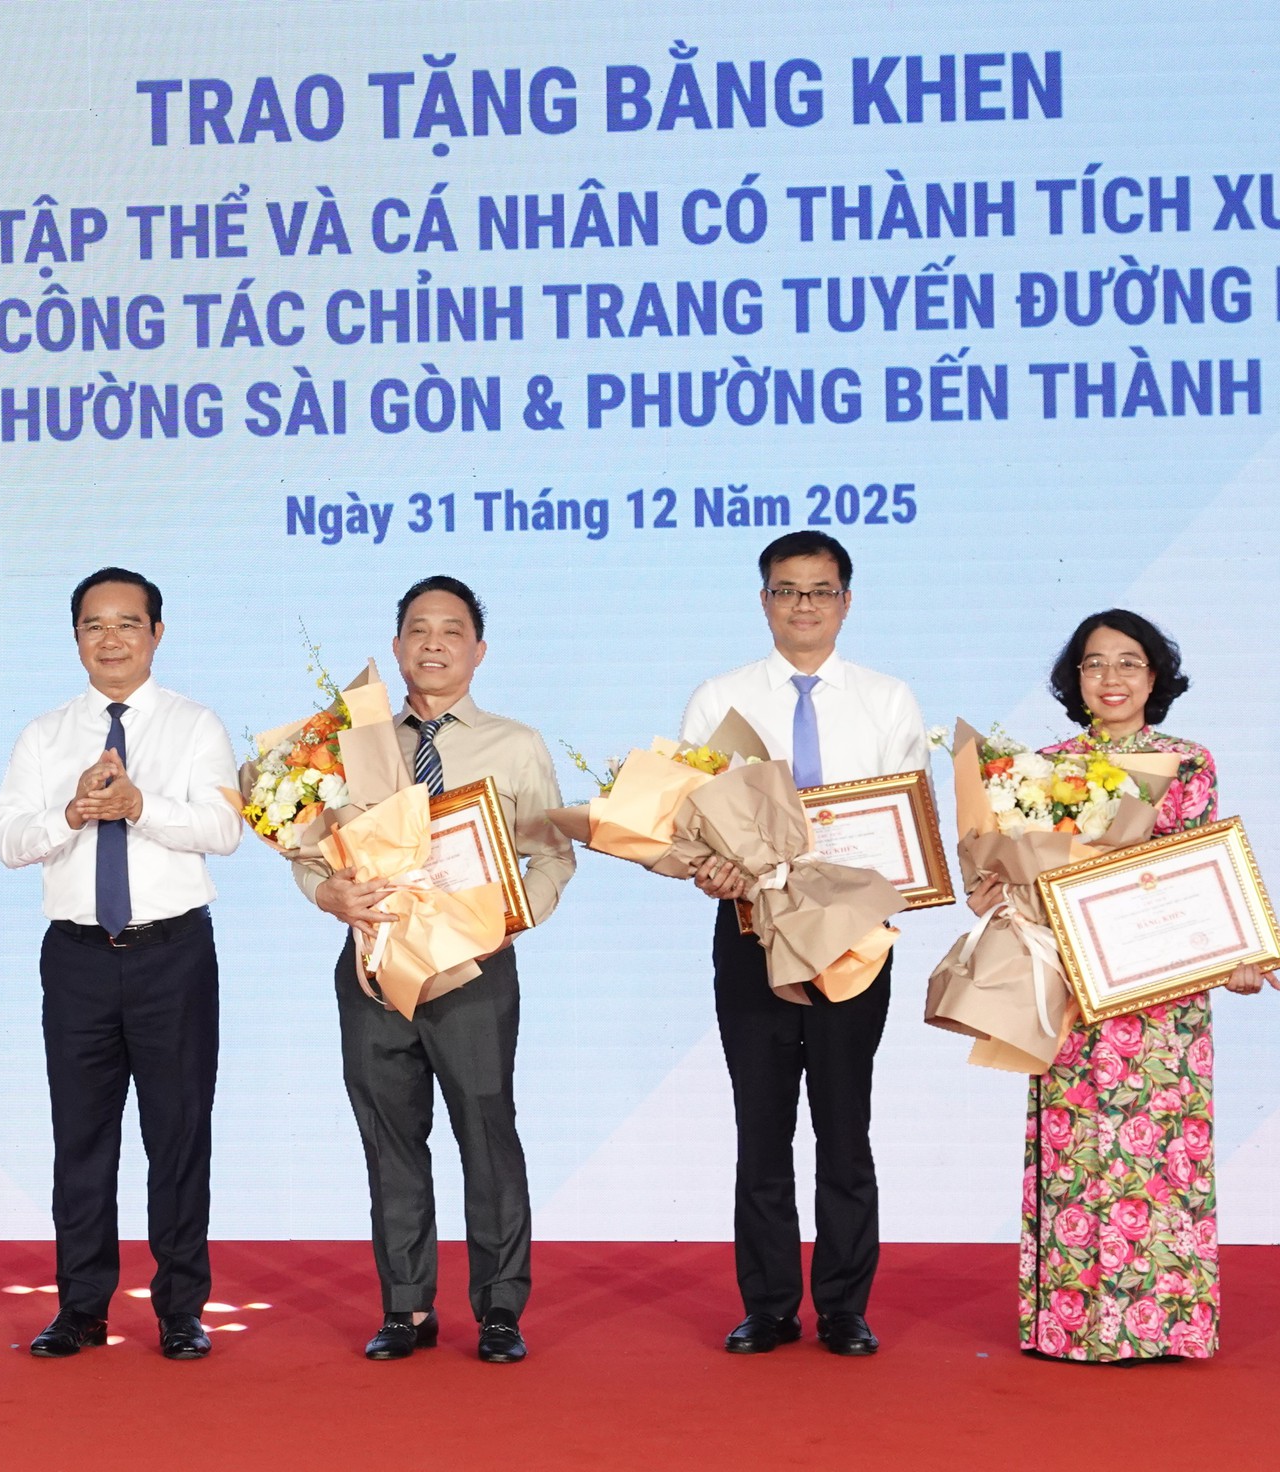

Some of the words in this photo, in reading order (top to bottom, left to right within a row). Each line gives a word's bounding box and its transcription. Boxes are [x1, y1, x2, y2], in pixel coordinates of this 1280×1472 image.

[135, 73, 345, 146] TRAO
[367, 52, 578, 158] TẶNG
[605, 38, 825, 133] BẰNG
[851, 49, 1064, 126] KHEN
[127, 183, 251, 261] THỂ
[267, 185, 352, 257] VÀ
[371, 181, 459, 255] CÁ
[478, 177, 659, 251] NHÂN
[681, 172, 768, 246] CÓ
[785, 168, 1017, 243] THÀNH
[1035, 161, 1192, 236] TÍCH
[182, 277, 305, 349] TÁC
[325, 268, 524, 346] CHỈNH
[542, 277, 764, 340] TRANG
[780, 254, 995, 334] TUYẾN
[1014, 253, 1253, 329] ĐƯỜNG
[244, 365, 347, 438] SÀI
[370, 362, 502, 435] GÒN
[522, 373, 566, 431] &
[586, 354, 863, 430] PHƯỜNG
[884, 345, 1009, 424] BẾN
[1028, 344, 1263, 420] THÀNH
[286, 490, 395, 546] Ngày
[407, 491, 456, 534] 31
[473, 486, 610, 541] Tháng
[626, 486, 678, 530] 12
[693, 483, 791, 529] Năm
[805, 482, 918, 526] 2025
